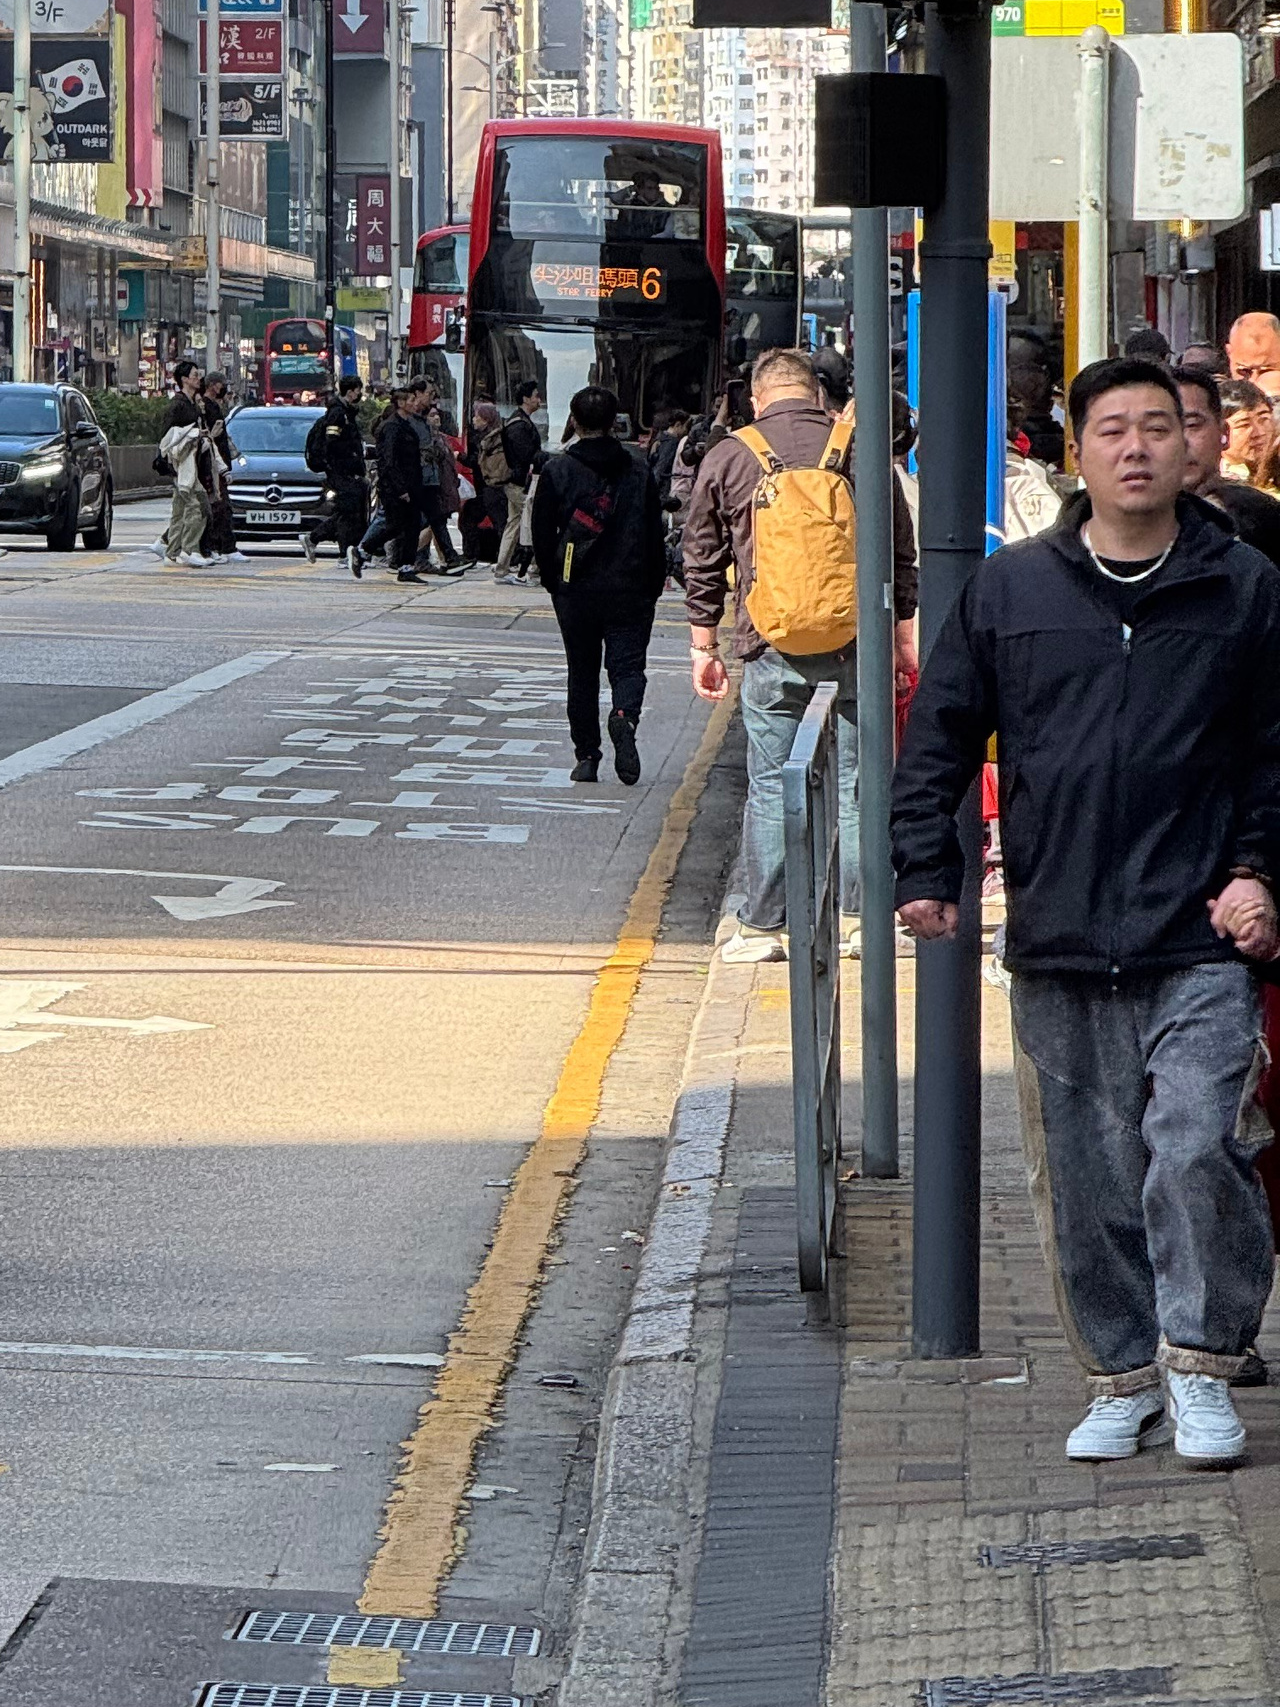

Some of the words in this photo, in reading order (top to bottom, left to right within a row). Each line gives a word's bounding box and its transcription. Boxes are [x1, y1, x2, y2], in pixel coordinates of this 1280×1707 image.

[34, 1, 65, 23] 3/F
[995, 7, 1021, 22] 970
[255, 27, 276, 40] 2/F
[253, 84, 281, 99] 5/F
[56, 123, 108, 134] OUTDARK
[366, 189, 384, 263] 周大福
[533, 263, 640, 289] 尖沙咀碼頭
[641, 267, 662, 300] 6
[557, 287, 580, 297] STAR
[585, 287, 614, 298] FERRY
[268, 512, 296, 522] 1597
